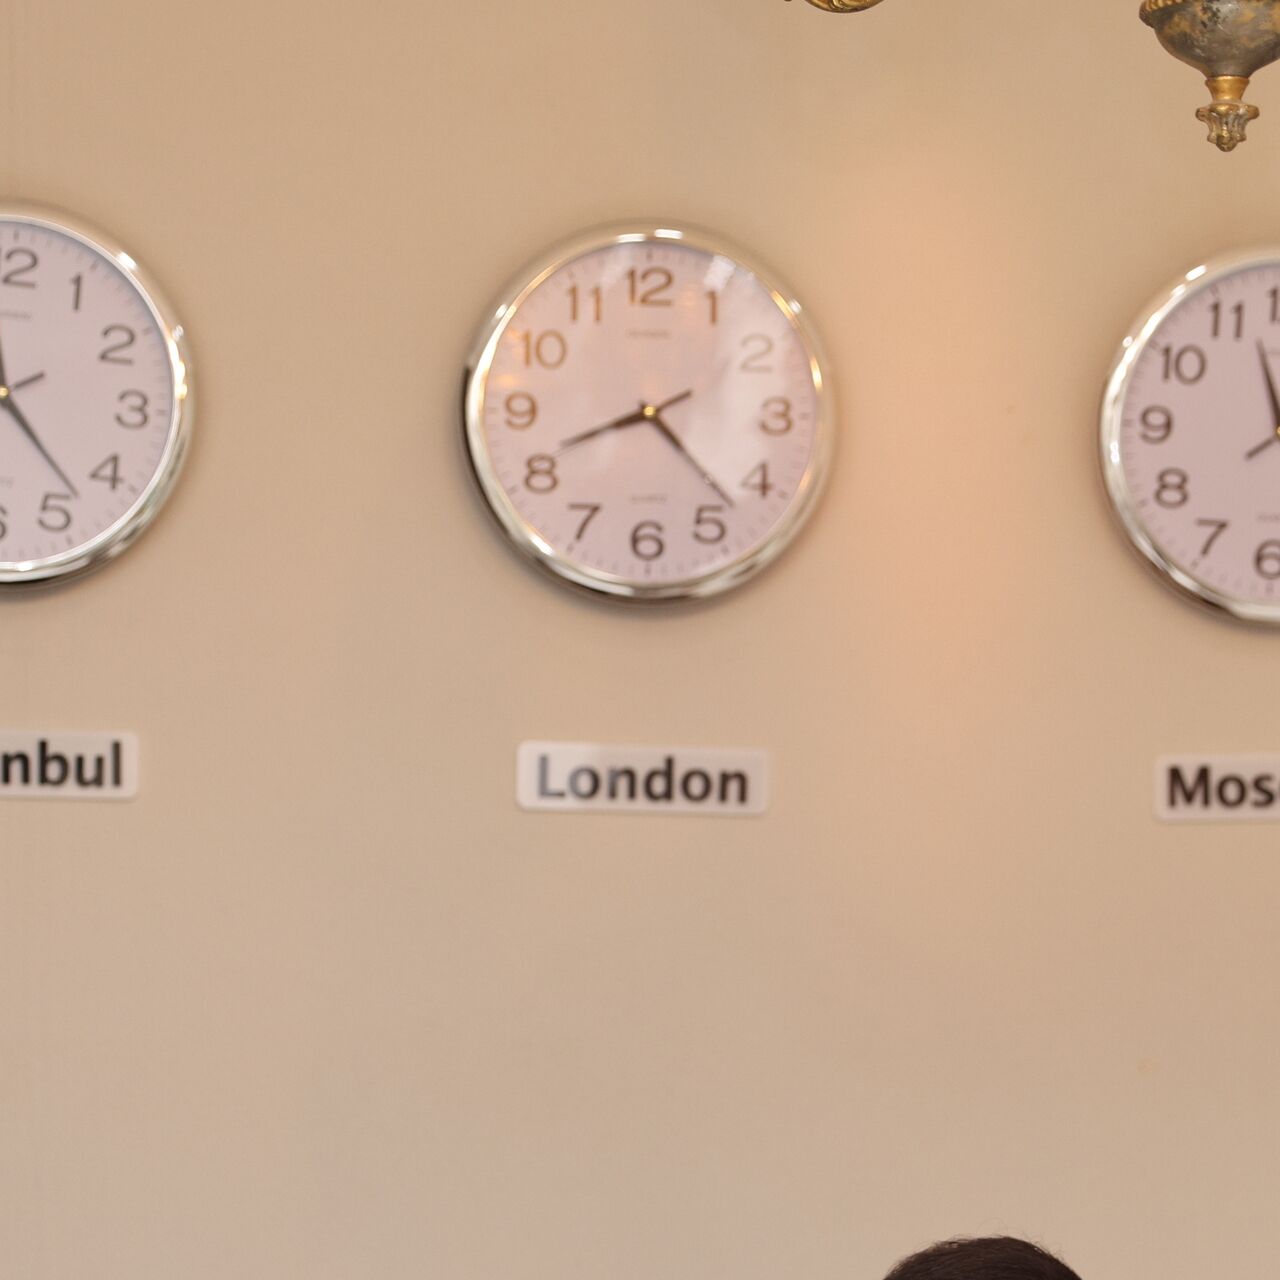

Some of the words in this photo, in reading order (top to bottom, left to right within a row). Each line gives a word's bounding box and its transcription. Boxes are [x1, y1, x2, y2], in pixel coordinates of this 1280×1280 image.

[70, 273, 82, 312] 1
[566, 285, 602, 323] 11
[627, 267, 674, 306] 12
[704, 290, 718, 326] 1
[1208, 301, 1244, 341] 11
[99, 326, 135, 365] 2
[523, 329, 567, 370] 10
[740, 335, 774, 373] 2
[1163, 345, 1206, 385] 10
[115, 390, 149, 429] 3
[505, 392, 538, 429] 9
[759, 398, 793, 436] 3
[1140, 405, 1173, 444] 9
[89, 454, 123, 490] 4
[524, 455, 559, 494] 8
[741, 463, 773, 498] 4
[1154, 468, 1189, 508] 8
[38, 493, 72, 533] 5
[567, 504, 602, 541] 7
[693, 505, 727, 544] 5
[630, 521, 665, 560] 6
[1196, 519, 1231, 557] 7
[537, 754, 748, 804] London
